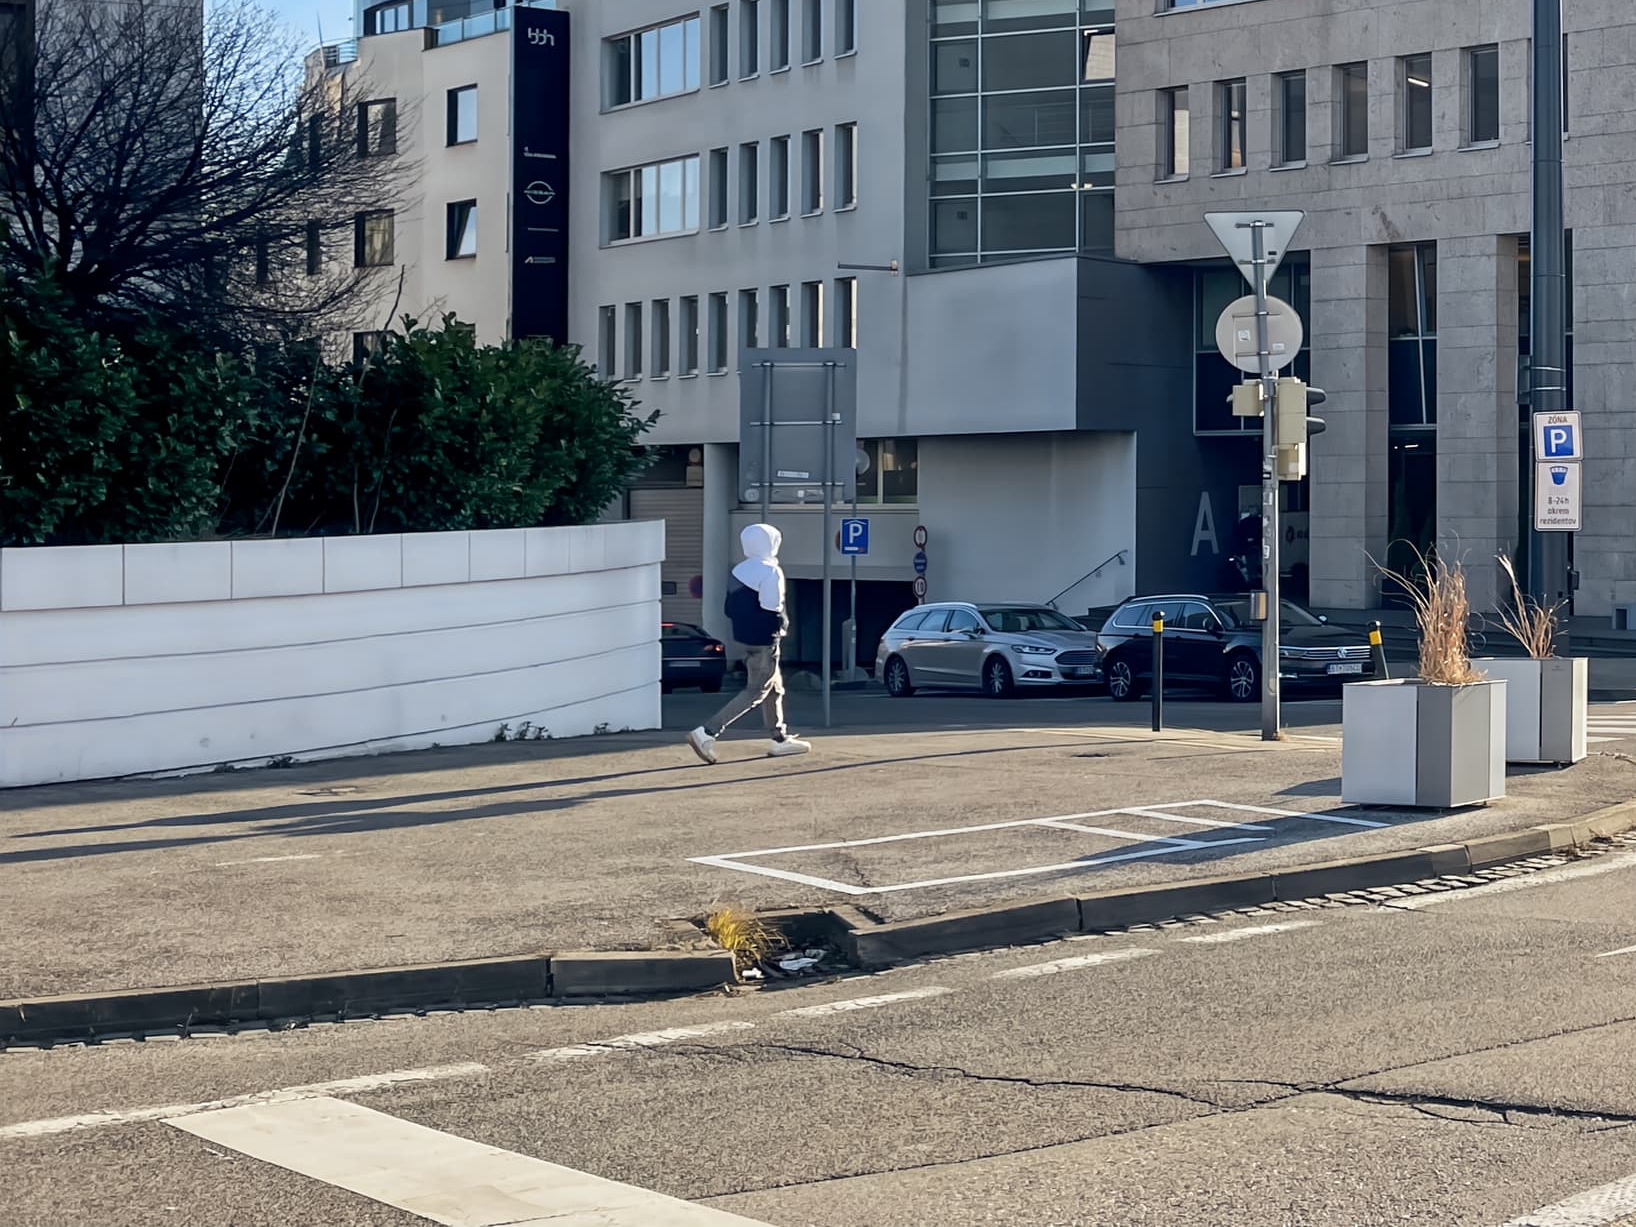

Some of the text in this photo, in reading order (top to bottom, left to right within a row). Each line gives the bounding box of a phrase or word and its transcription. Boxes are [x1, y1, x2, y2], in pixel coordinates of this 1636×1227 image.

[1551, 429, 1567, 453] P
[849, 523, 863, 544] P
[1190, 491, 1219, 556] A
